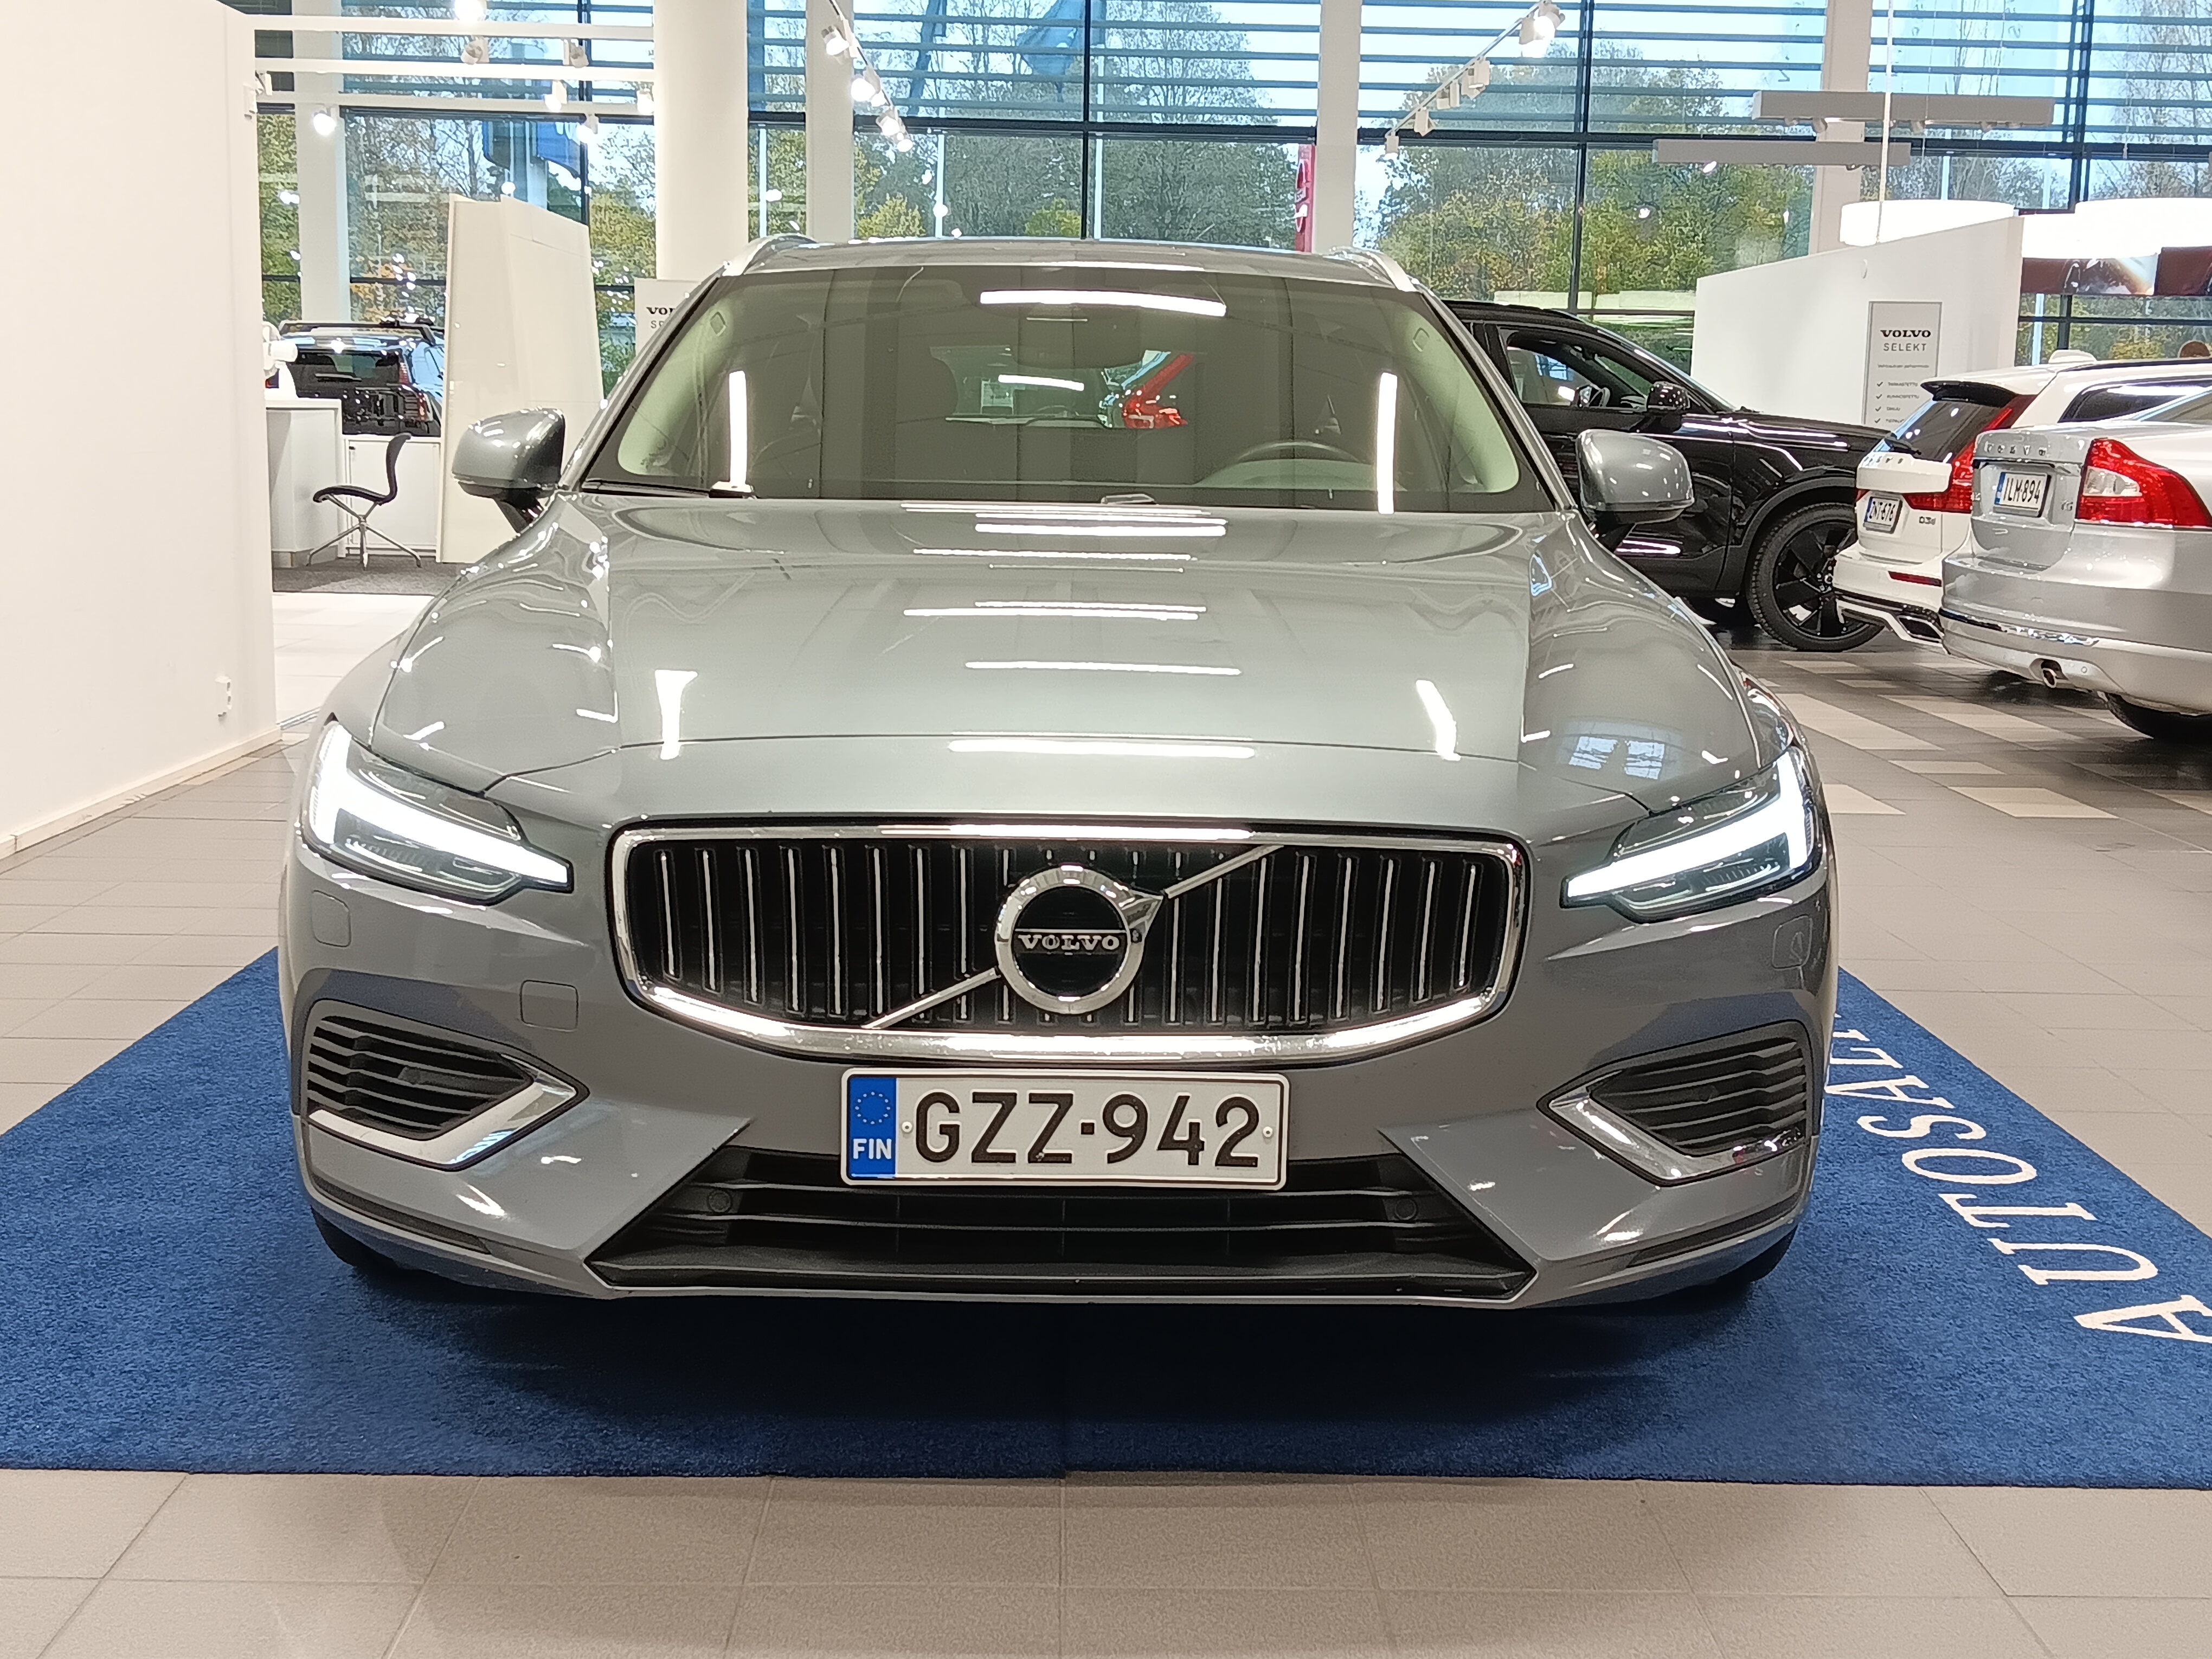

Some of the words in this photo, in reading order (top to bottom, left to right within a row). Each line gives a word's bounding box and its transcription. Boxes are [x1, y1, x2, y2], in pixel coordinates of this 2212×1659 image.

[1883, 343, 1927, 351] SELEKT
[1018, 934, 1120, 950] VOLVO
[915, 1092, 1259, 1168] GZZ-942
[852, 1139, 892, 1160] FIN
[1824, 1013, 2212, 1343] AUTOSAL
